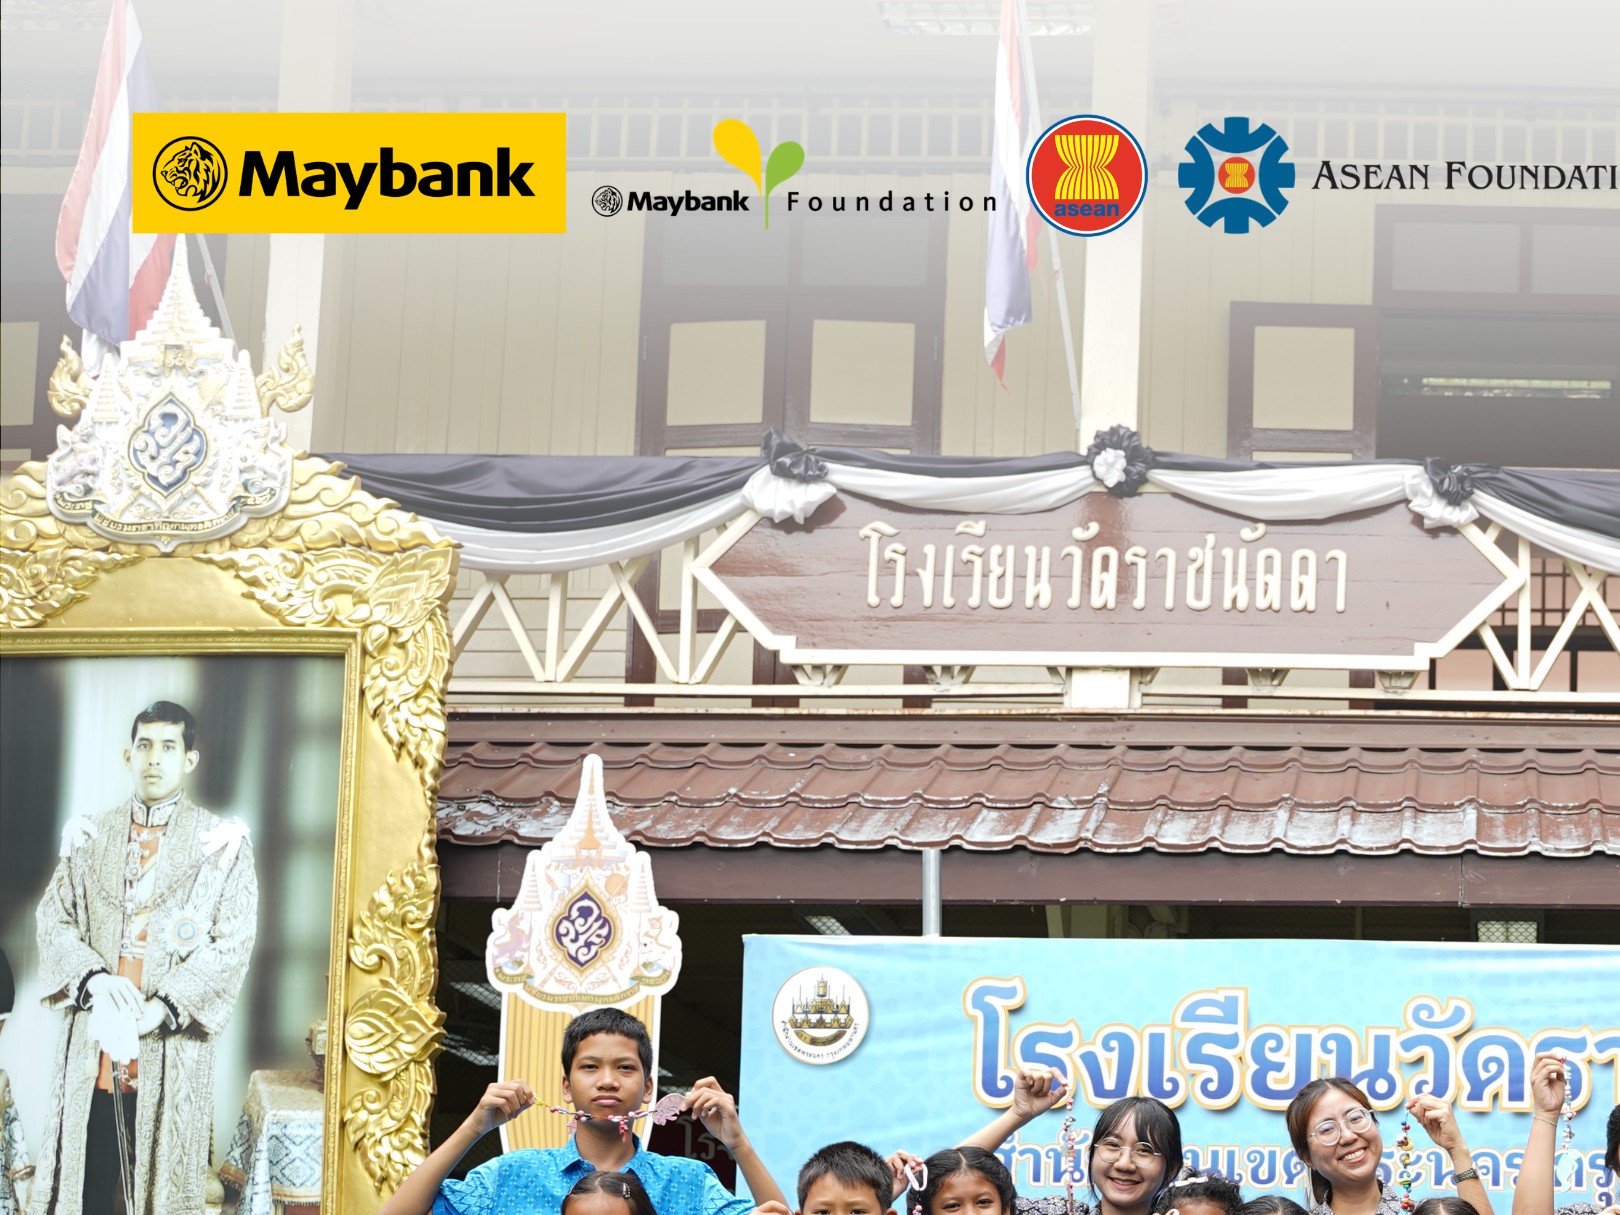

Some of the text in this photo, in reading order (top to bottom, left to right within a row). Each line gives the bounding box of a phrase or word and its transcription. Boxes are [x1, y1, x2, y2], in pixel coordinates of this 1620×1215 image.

[859, 520, 1348, 614] โรงเรียนวัดราชนัดดา
